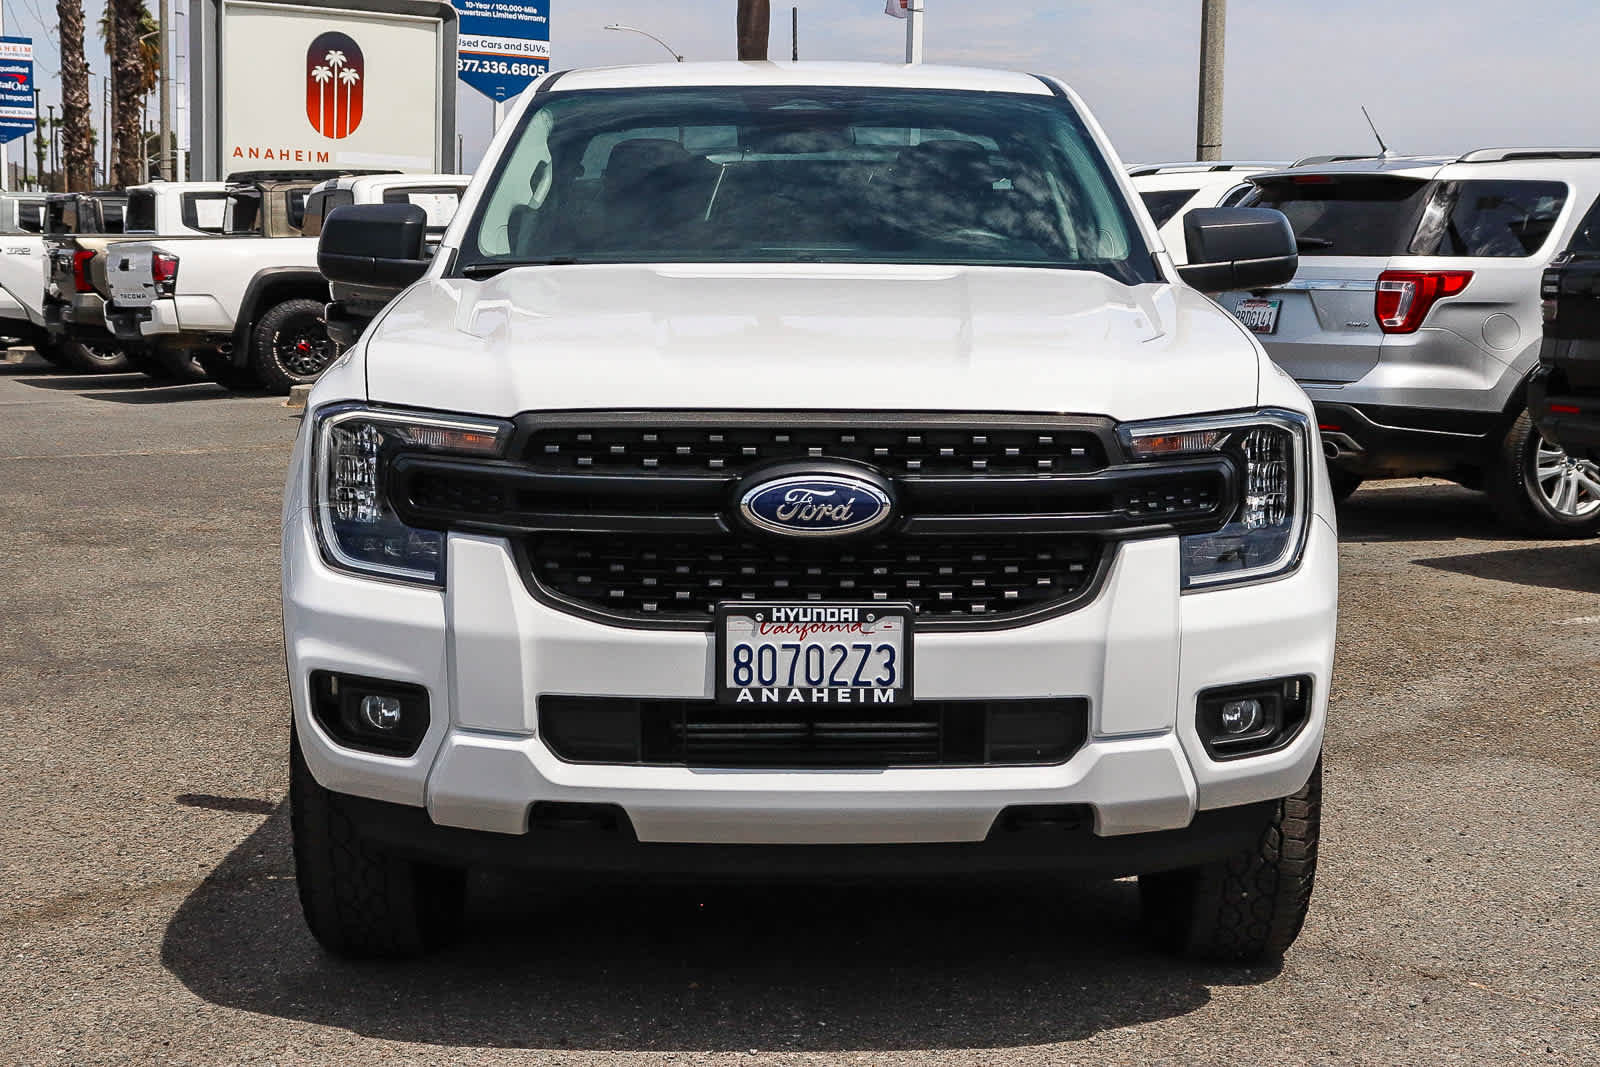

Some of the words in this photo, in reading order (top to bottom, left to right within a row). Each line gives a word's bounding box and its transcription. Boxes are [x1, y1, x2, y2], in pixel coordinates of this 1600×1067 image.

[465, 1, 490, 10] 10-Year
[493, 11, 517, 20] Limited
[517, 13, 547, 23] Warranty
[481, 40, 502, 49] Cars
[504, 42, 522, 51] and
[232, 146, 329, 163] ANAHEIM
[776, 488, 856, 521] Ford
[772, 607, 859, 622] HYUNDAI
[760, 622, 876, 641] California
[733, 643, 896, 687] 80702Z3
[736, 687, 895, 703] ANAHEIM
